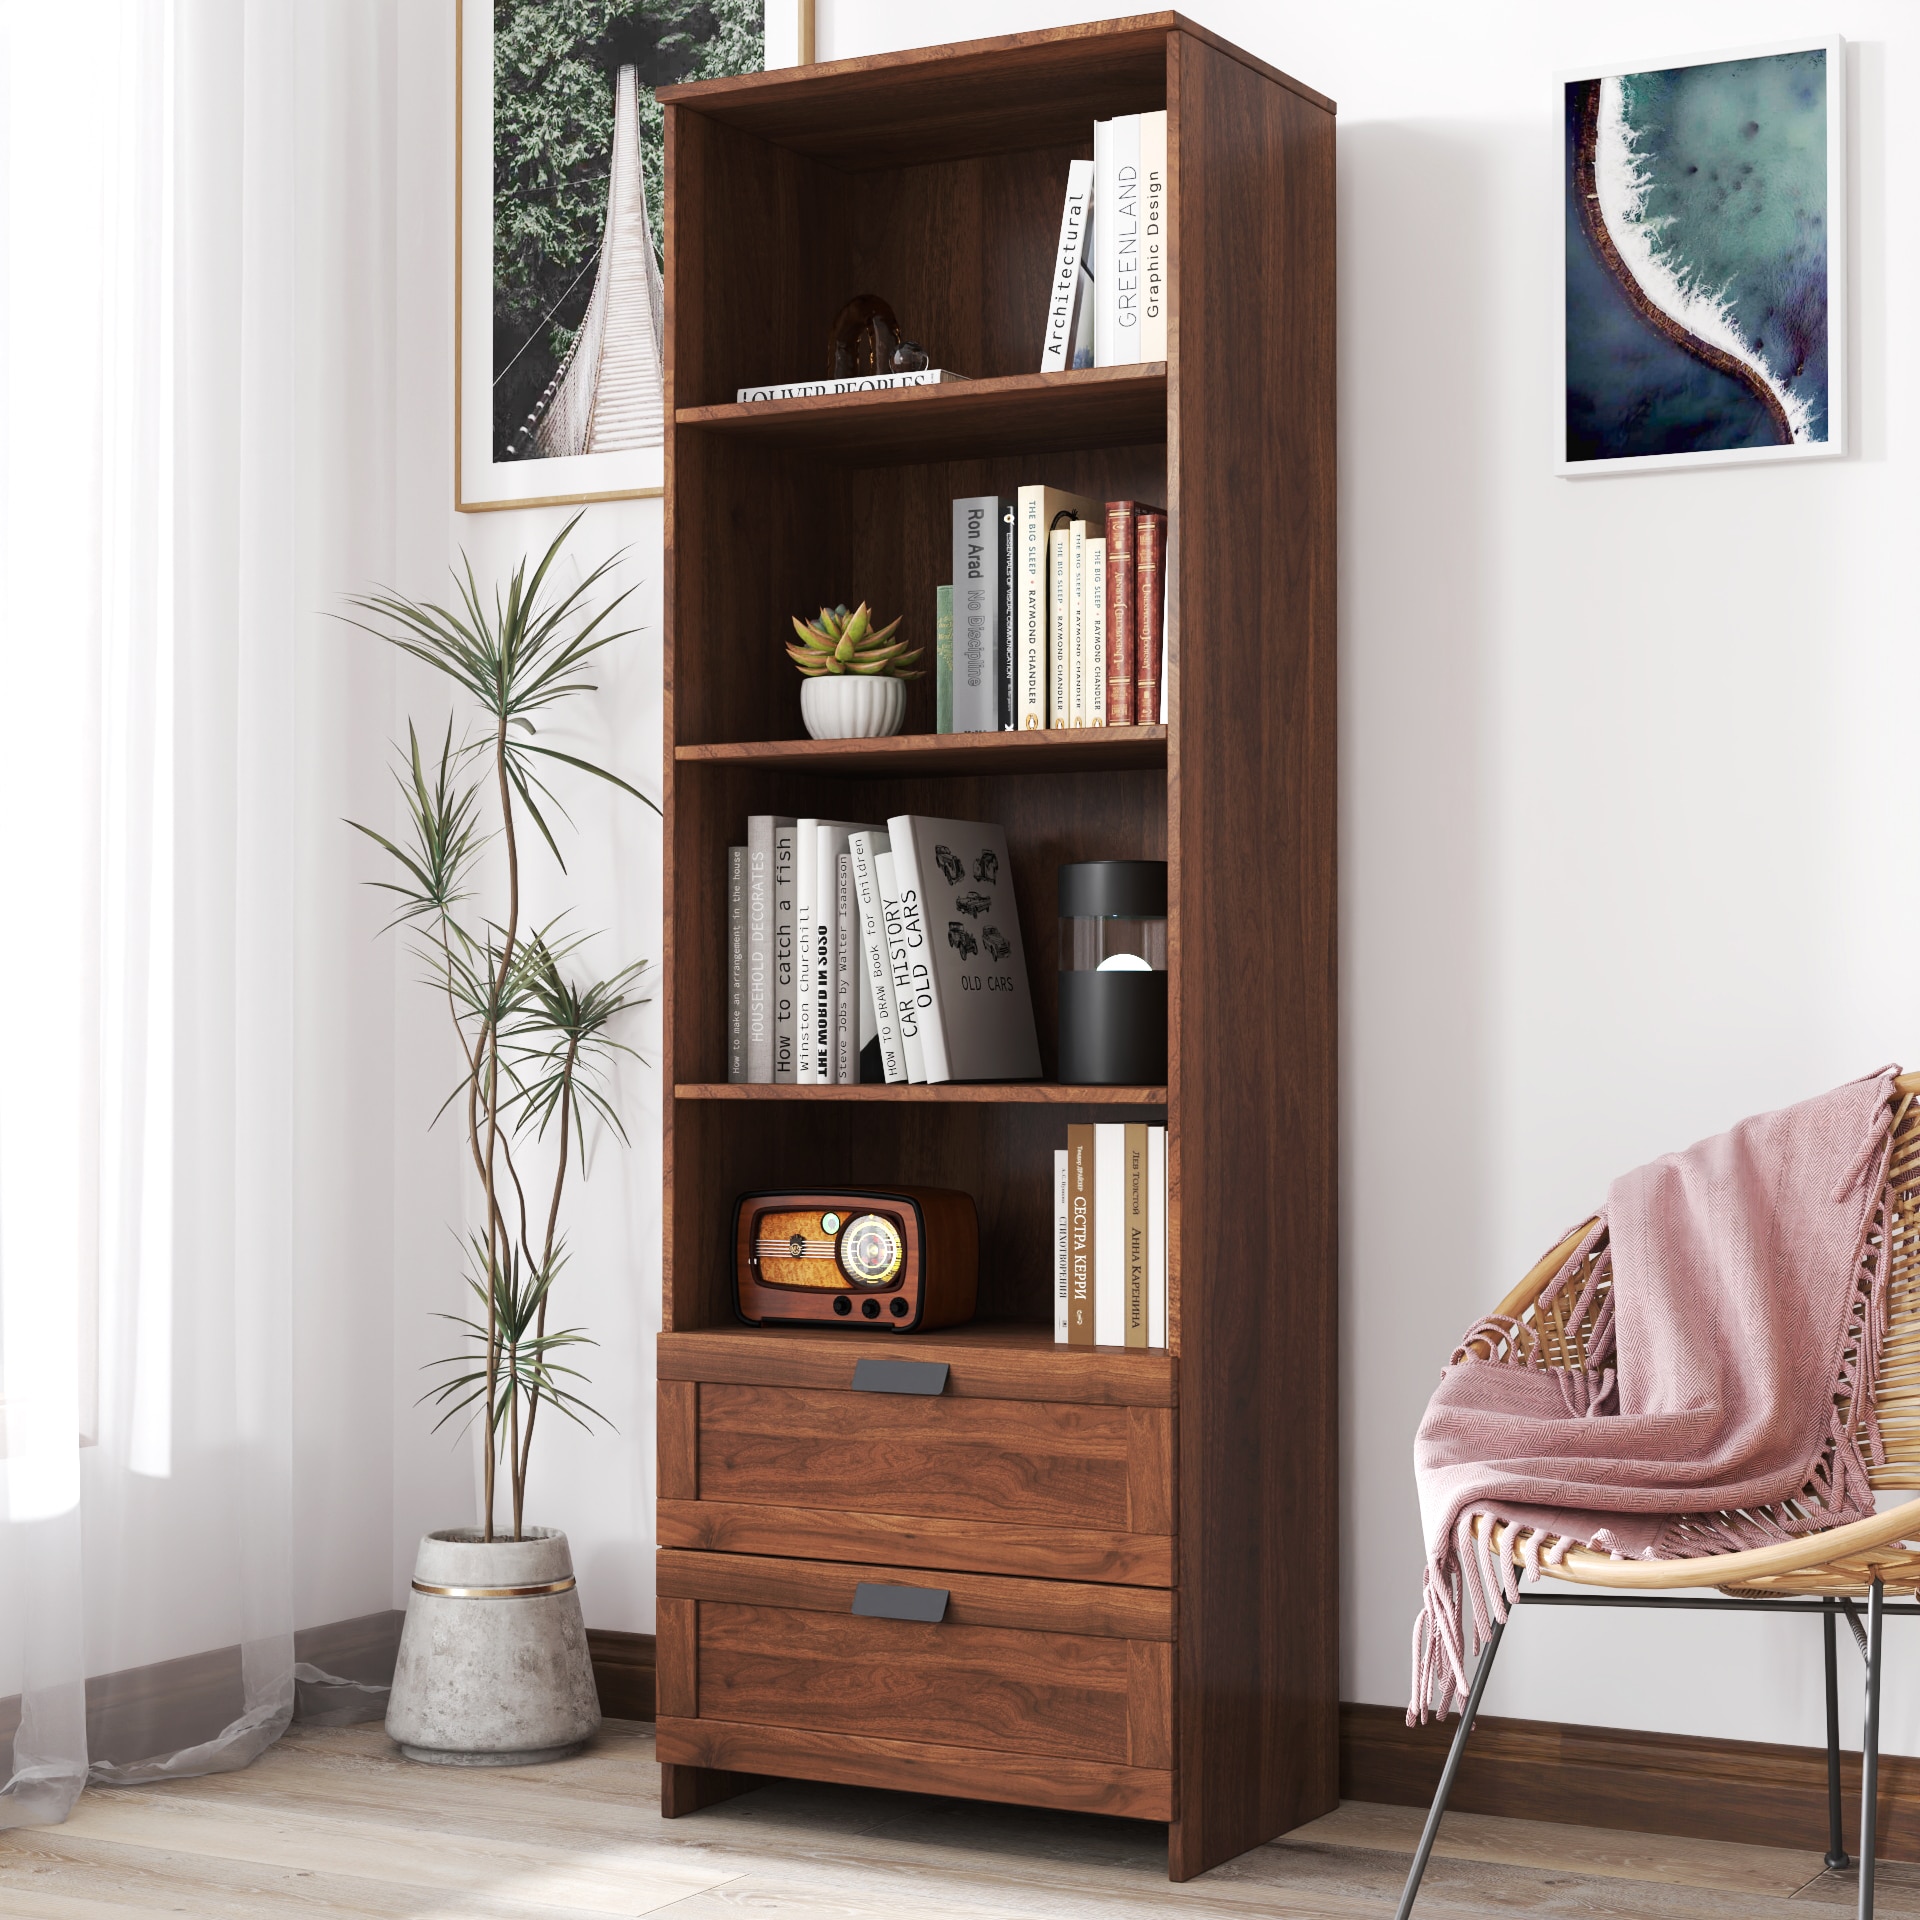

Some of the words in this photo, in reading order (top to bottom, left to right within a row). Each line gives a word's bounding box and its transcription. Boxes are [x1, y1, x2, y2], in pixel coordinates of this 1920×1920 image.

[1147, 172, 1161, 235] Design
[1119, 166, 1137, 327] GREENLAND
[1048, 194, 1083, 354] Architectural
[1147, 244, 1161, 318] Graphic
[968, 509, 984, 538] Ron
[968, 544, 984, 578] Arad
[968, 590, 985, 610] No
[965, 616, 985, 686] Discipline
[732, 852, 740, 880] house
[777, 838, 791, 885] fish
[854, 839, 871, 904] children
[732, 886, 740, 902] the
[752, 852, 764, 941] DECORATES
[839, 856, 847, 917] Isaacson
[732, 908, 740, 920] in
[780, 900, 791, 911] a
[901, 890, 922, 948] CARS
[865, 914, 876, 935] for
[883, 898, 910, 985] HISTORY
[732, 925, 742, 988] arrangement
[777, 925, 791, 985] catch
[800, 905, 809, 992] Churchill
[839, 926, 847, 971] Walter
[870, 945, 882, 977] Book
[734, 994, 740, 1005] an
[752, 952, 764, 1042] HOUSEHOLD
[839, 980, 849, 994] by
[876, 985, 888, 1018] DRAW
[913, 964, 932, 1008] OLD
[962, 975, 981, 991] OLD
[988, 976, 1014, 991] CARS
[732, 1010, 740, 1034] make
[779, 999, 791, 1022] to
[839, 1002, 847, 1031] Jobs
[899, 1000, 918, 1037] CAR
[733, 1040, 740, 1050] to
[800, 1003, 809, 1071] Winston
[881, 1027, 892, 1043] TO
[732, 1056, 740, 1073] How
[777, 1036, 791, 1072] How
[839, 1041, 847, 1078] Steve
[886, 1051, 898, 1076] HOW
[1132, 1151, 1140, 1169] ЛЕВ
[1132, 1172, 1140, 1215] ТОЛСТОЙ
[1075, 1197, 1086, 1250] СЕСТРА
[1059, 1216, 1067, 1298] СТИХОТВОРЕНИЯ
[1132, 1227, 1141, 1262] АННА
[1075, 1255, 1086, 1299] КЕРРИ
[1132, 1266, 1141, 1328] КАРЕНИНА
